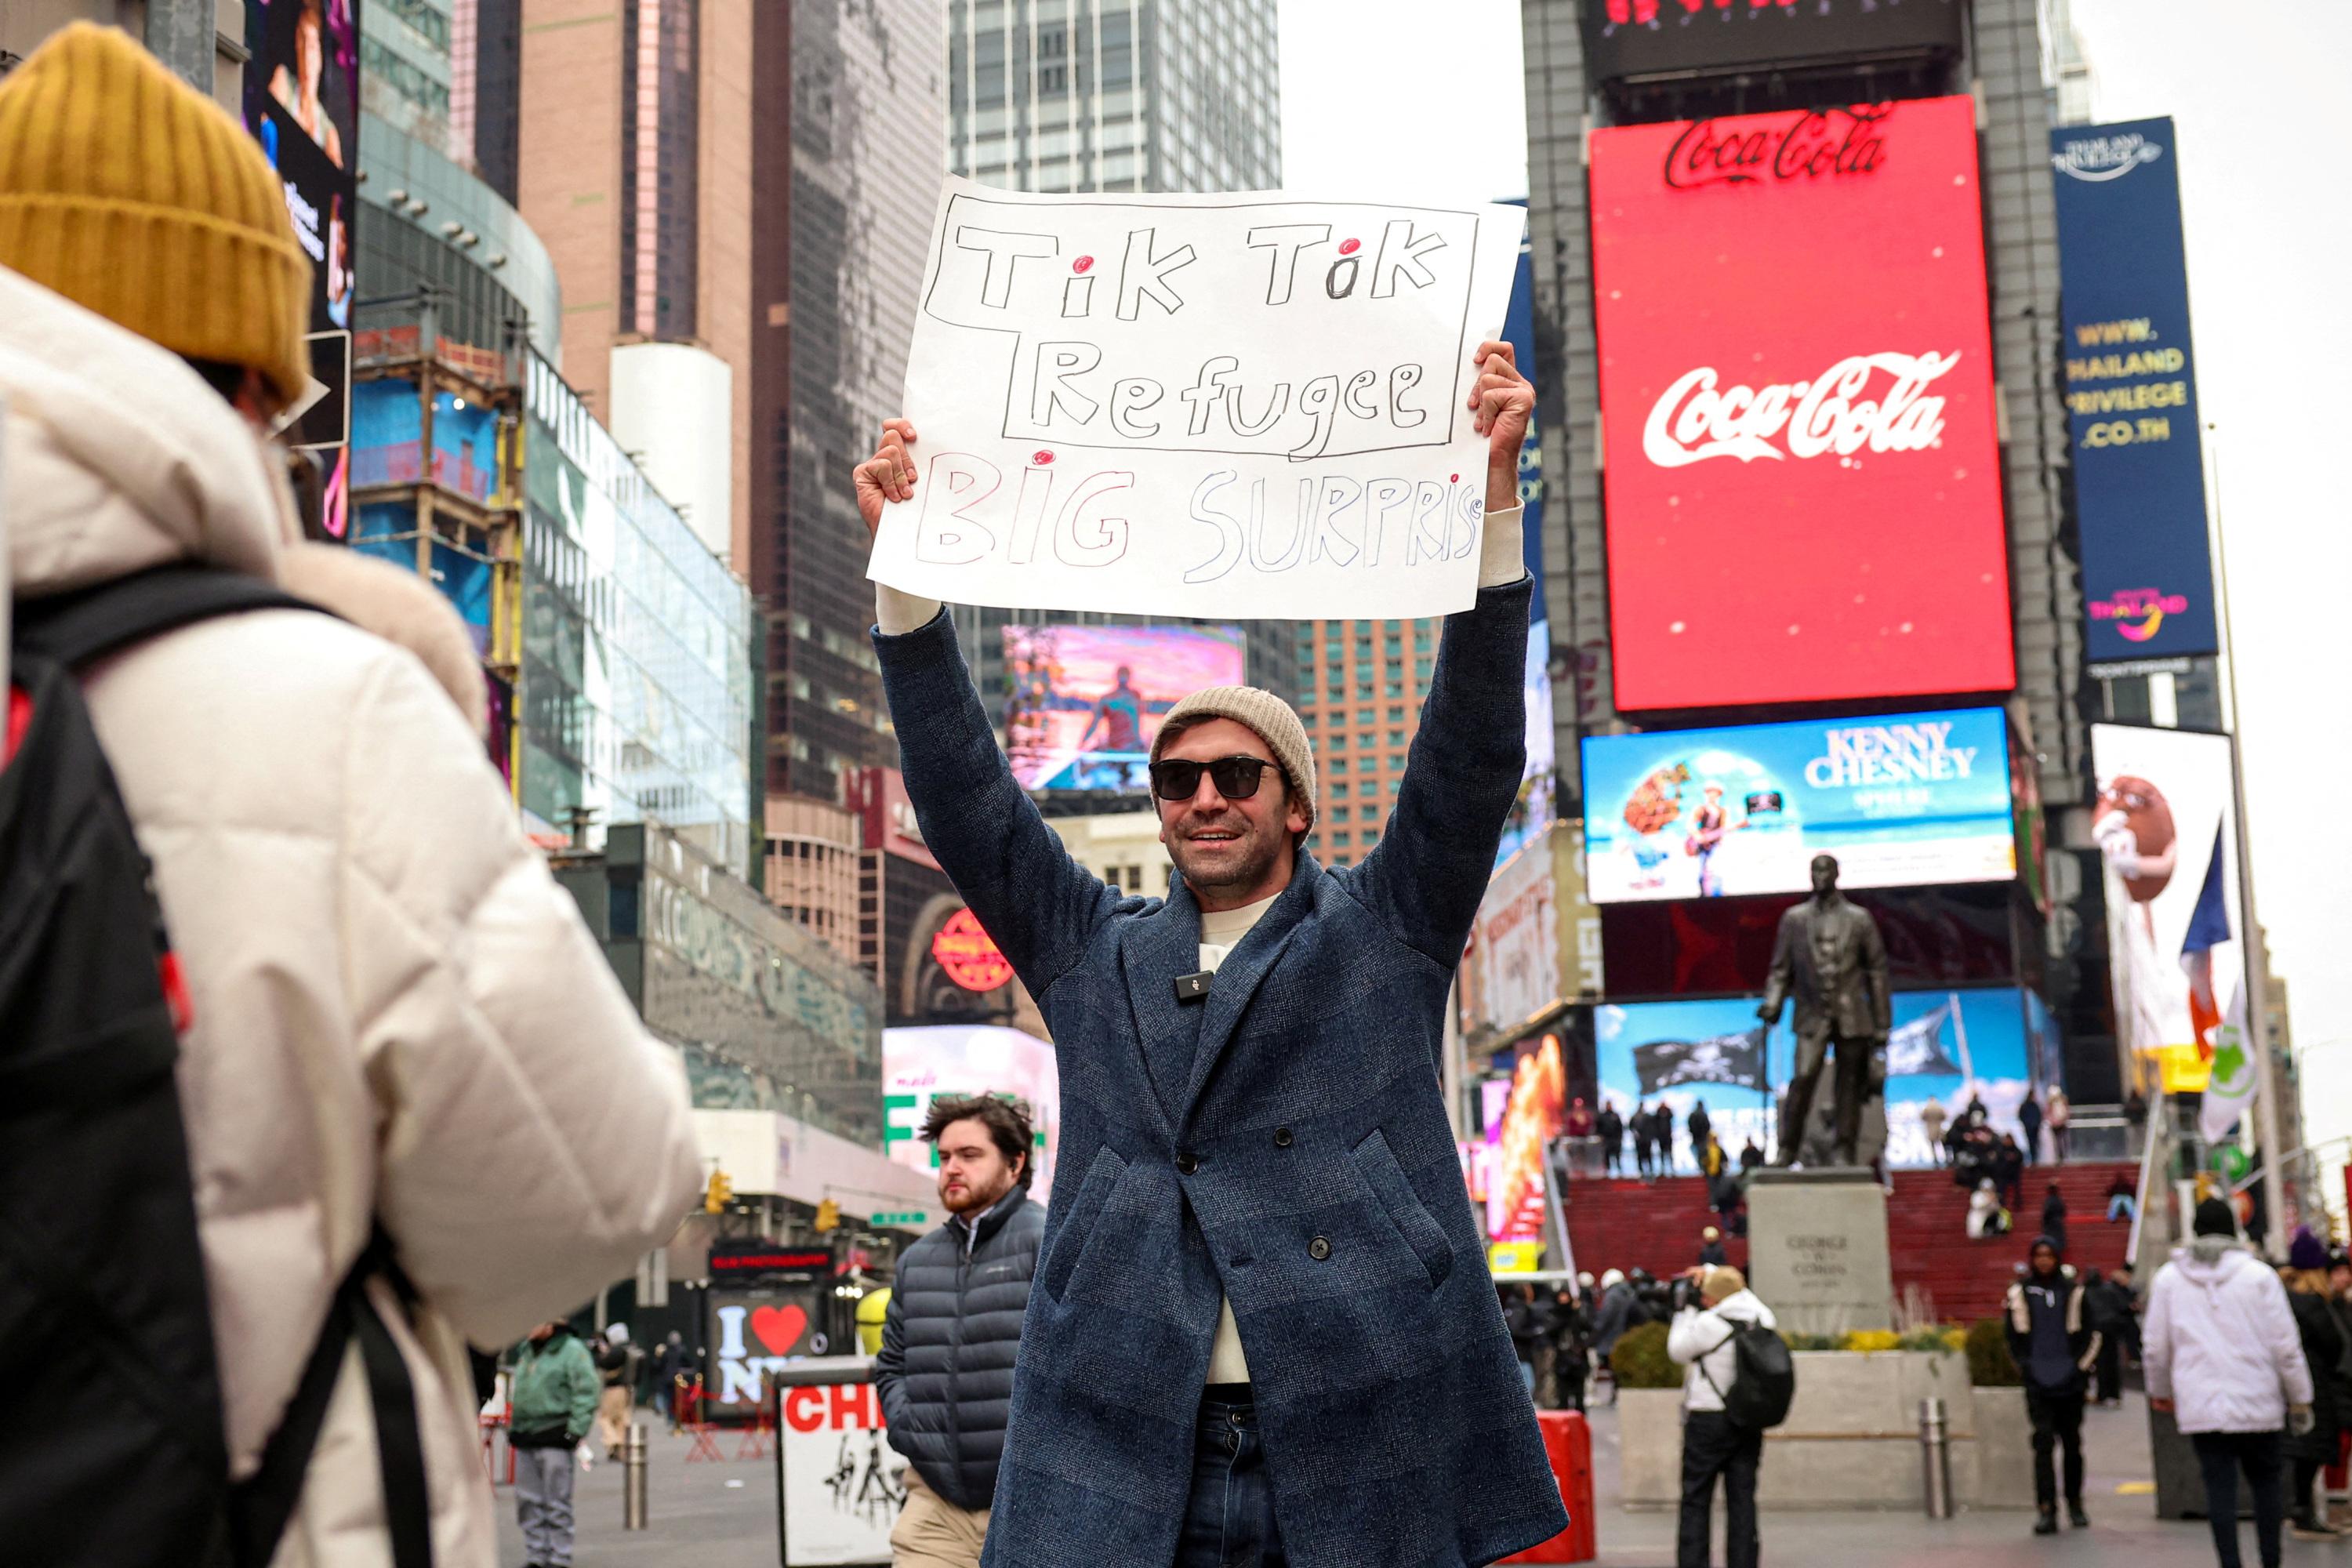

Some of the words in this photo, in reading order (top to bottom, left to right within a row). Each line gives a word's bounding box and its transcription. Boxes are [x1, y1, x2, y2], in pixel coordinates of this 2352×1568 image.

[1664, 102, 1893, 189] Coca-Cola
[2066, 347, 2184, 382] HAILAND
[1031, 341, 1426, 463] Refugee
[1642, 349, 1961, 468] Coca-Cola
[1825, 721, 1953, 759] KENNY
[1804, 746, 1978, 789] CHESNEY
[717, 1305, 747, 1359] I
